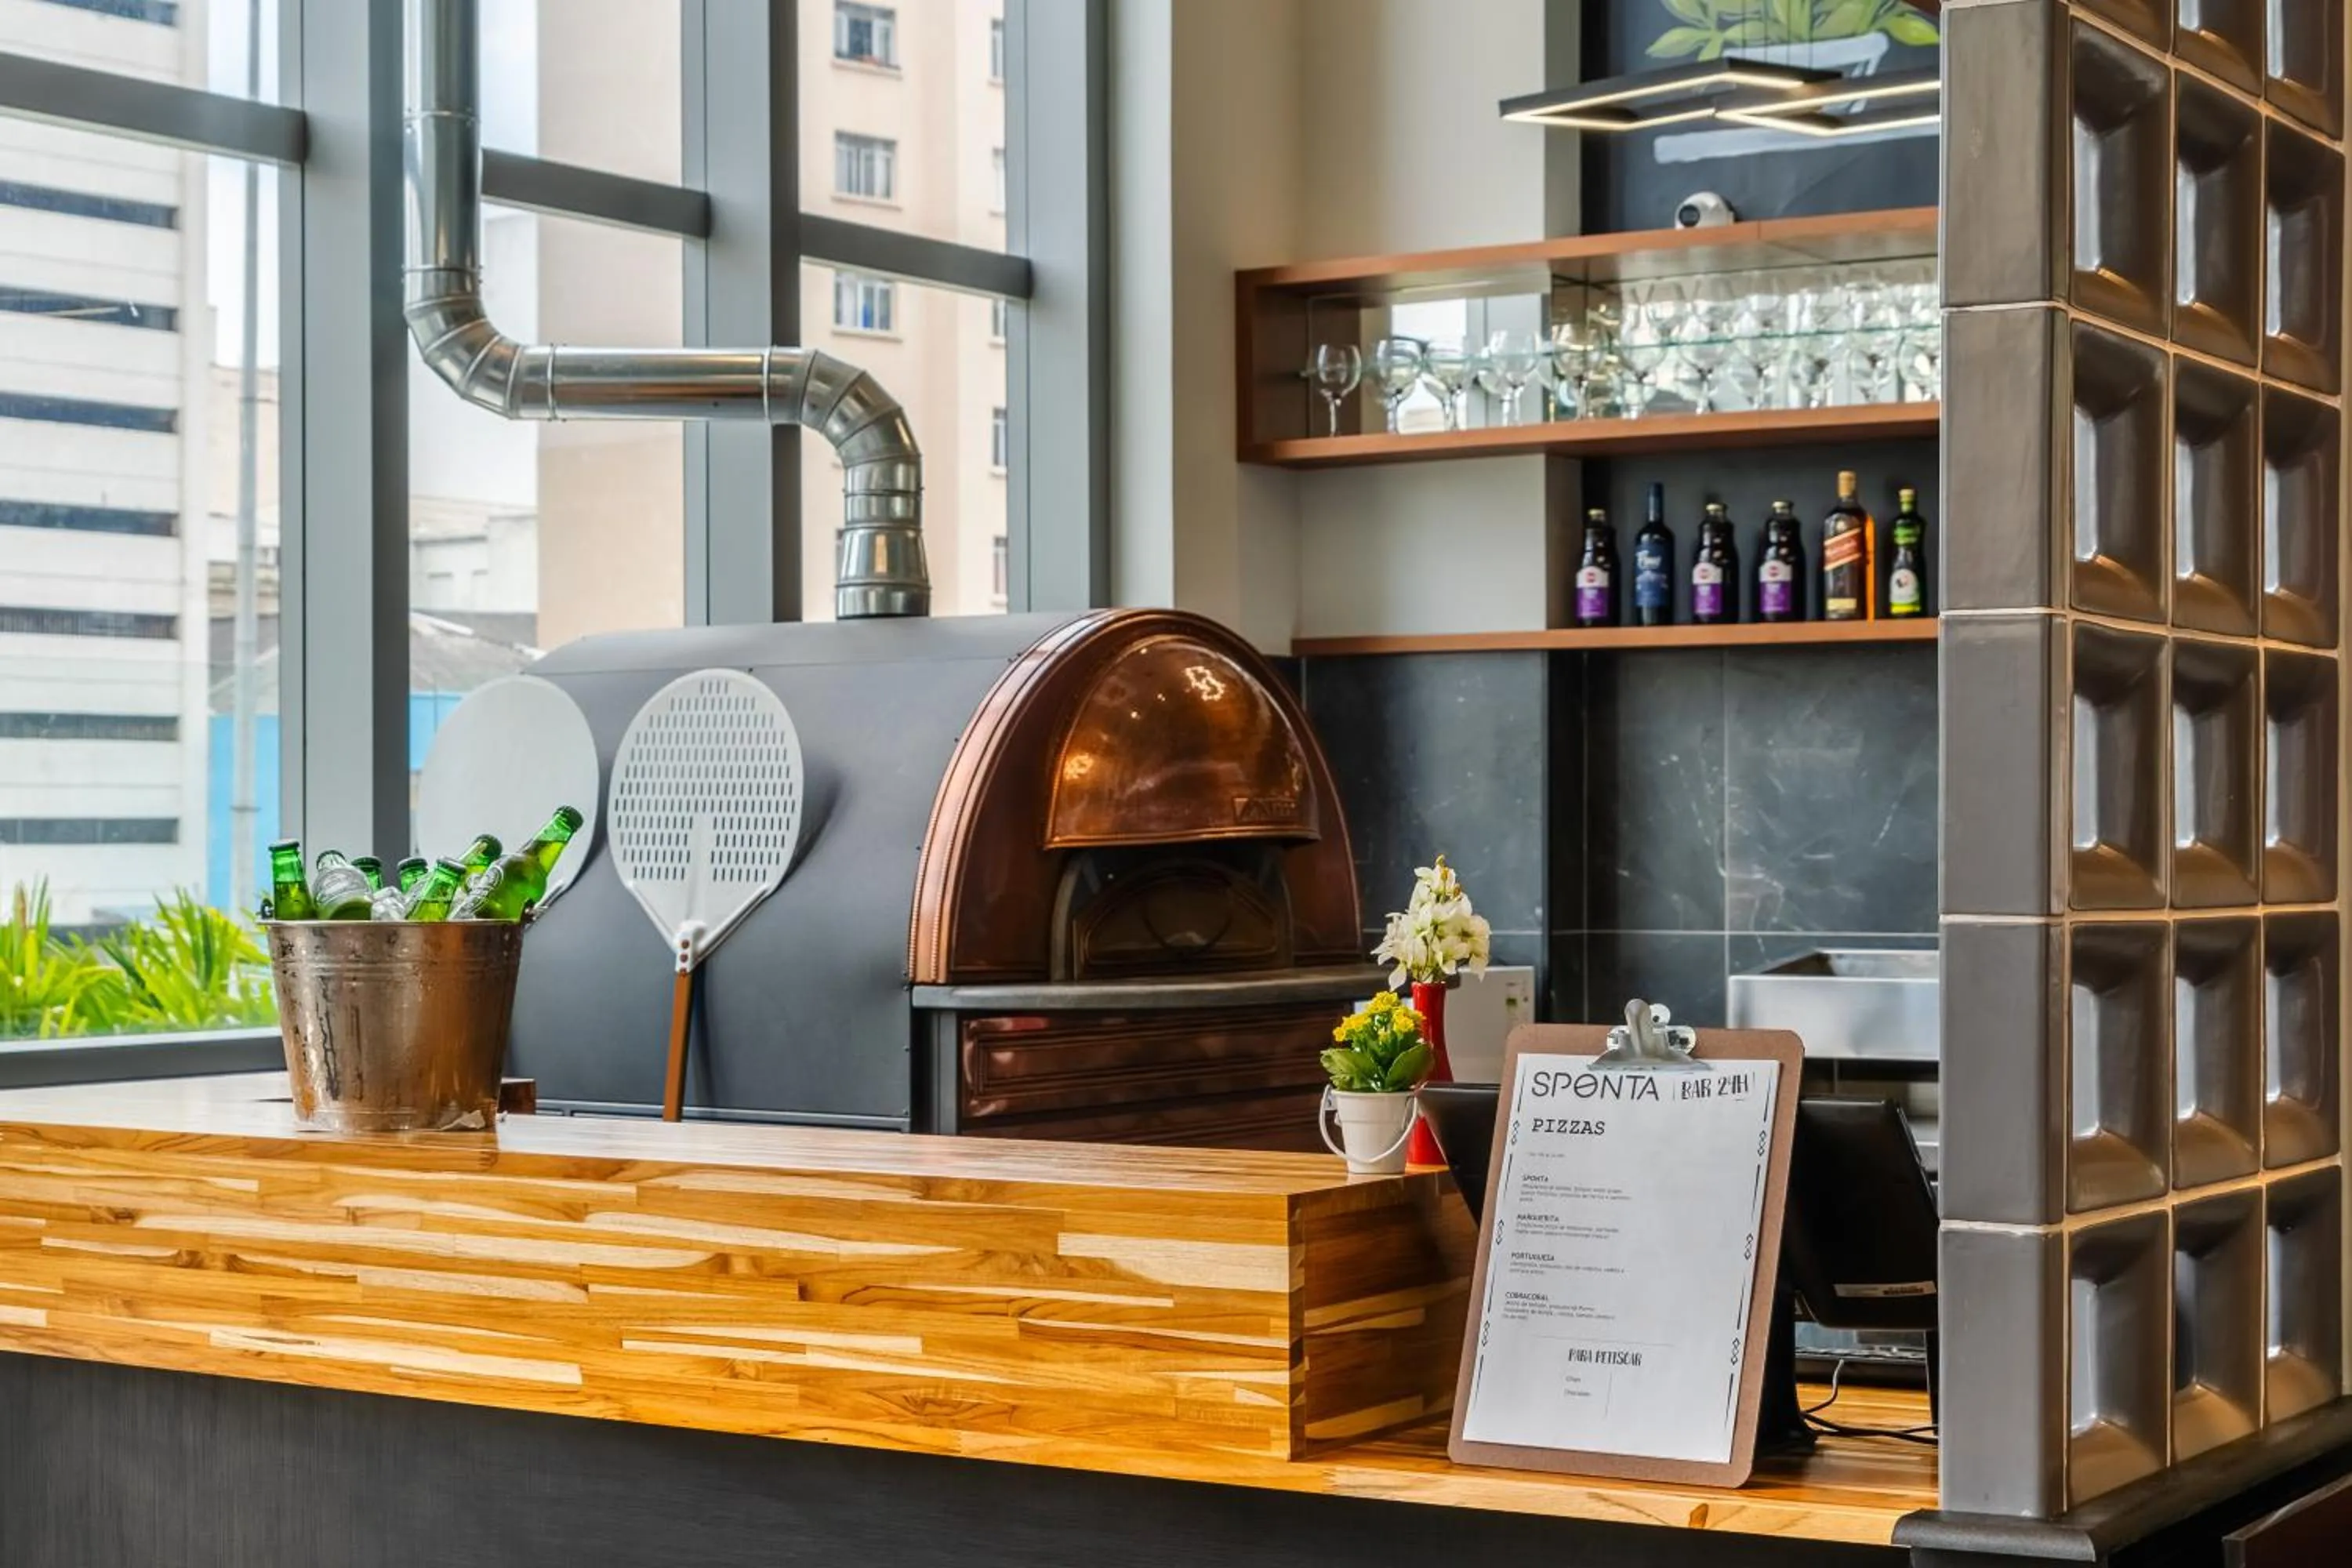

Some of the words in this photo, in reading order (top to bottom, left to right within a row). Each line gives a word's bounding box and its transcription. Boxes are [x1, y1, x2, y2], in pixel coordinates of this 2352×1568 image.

[1531, 1072, 1659, 1101] SPONTA
[1681, 1078, 1711, 1099] BAR
[1531, 1118, 1605, 1136] PIZZAS
[1568, 1348, 1592, 1363] PARA
[1595, 1349, 1642, 1366] PETISCAR
